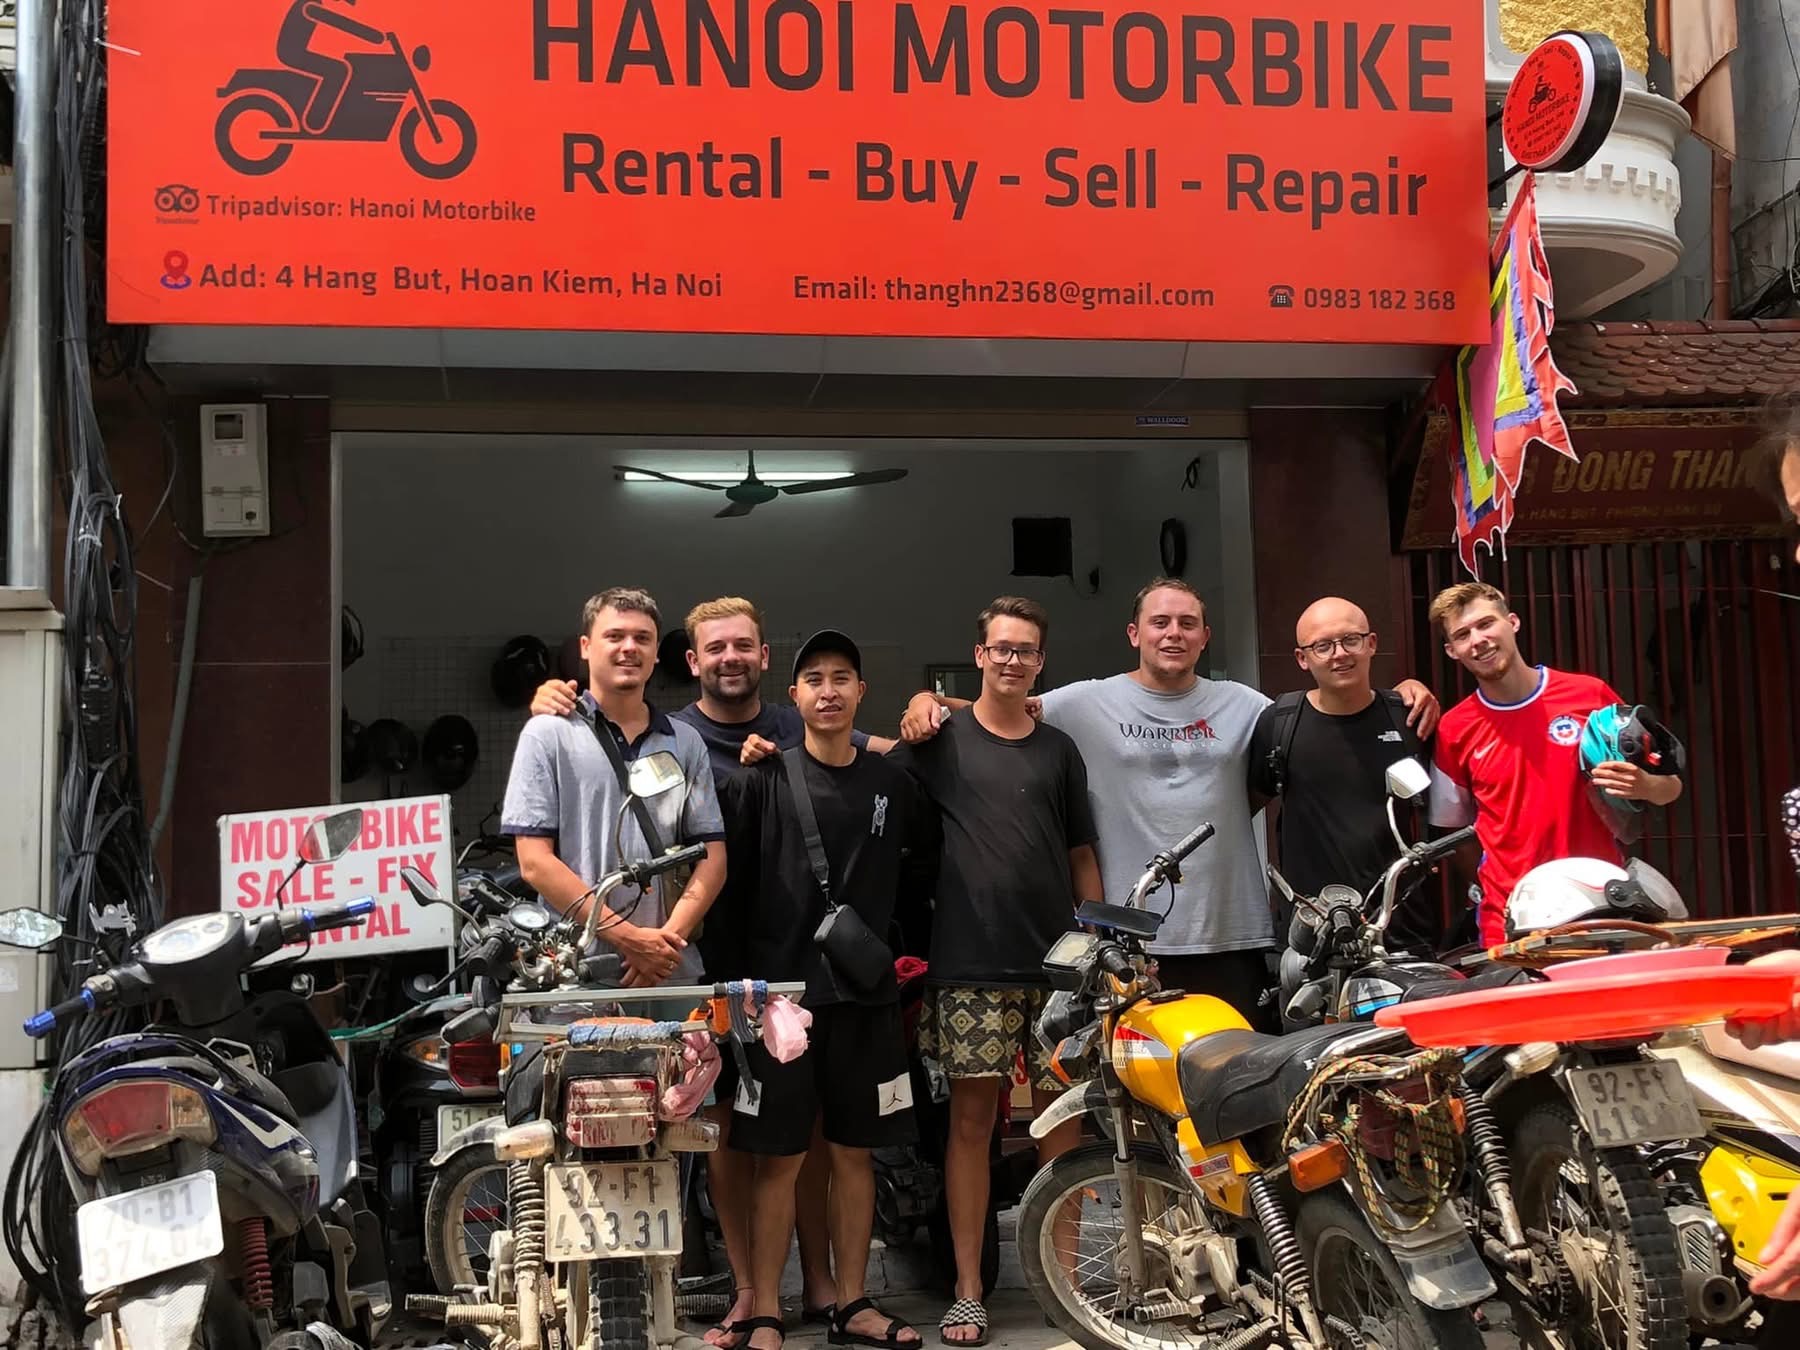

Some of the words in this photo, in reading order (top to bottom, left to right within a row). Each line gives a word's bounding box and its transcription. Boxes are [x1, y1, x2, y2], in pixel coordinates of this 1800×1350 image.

[533, 0, 854, 92] HANOI
[893, 3, 1453, 113] MOTORBIKE
[563, 133, 782, 199] Rental
[856, 142, 978, 220] Buy
[1045, 147, 1156, 208] Sell
[1226, 153, 1428, 230] Repair
[206, 195, 342, 221] Tripadvisor:
[350, 199, 415, 219] Hanoi
[423, 199, 536, 222] Motorbike
[199, 263, 266, 288] Add:
[275, 265, 294, 288] 4
[303, 265, 377, 296] Hang
[394, 266, 450, 294] But,
[460, 267, 533, 294] Hoan
[542, 269, 622, 298] Kiem,
[632, 272, 668, 296] Ha
[676, 273, 722, 297] Noi
[793, 275, 877, 300] Email:
[884, 278, 1215, 310] thanghn2368@gmail.com
[1304, 287, 1362, 310] 0983
[1368, 289, 1407, 310] 182
[1414, 290, 1457, 311] 368
[1119, 719, 1222, 743] WARRIOR
[231, 802, 442, 864] MOTBIKE
[236, 864, 335, 909] SALE
[562, 1166, 659, 1208] 92-F1
[554, 1208, 672, 1256] 433.31
